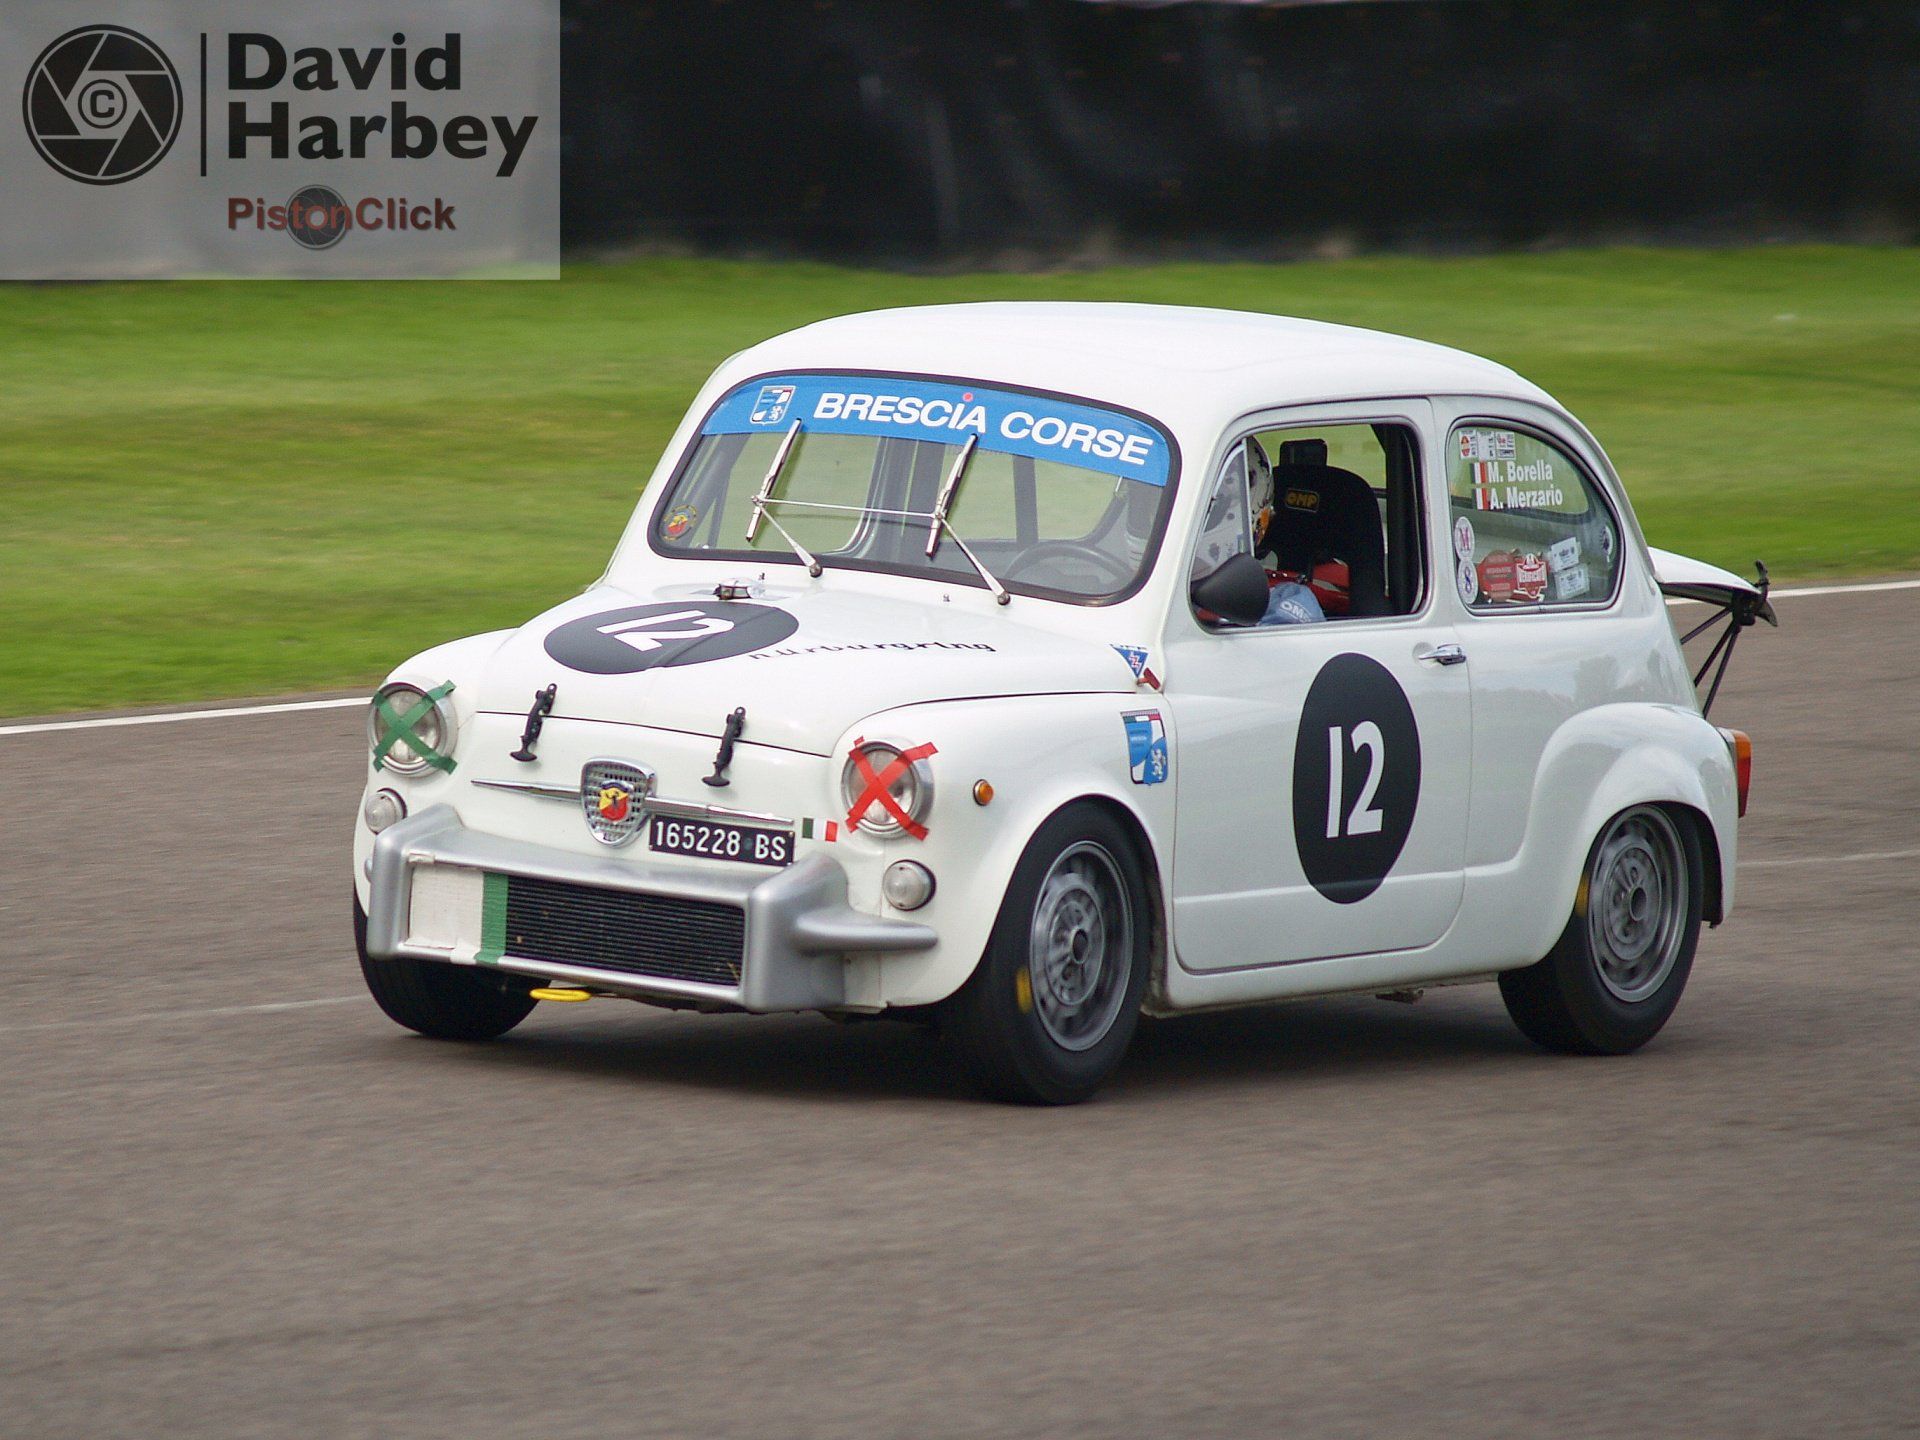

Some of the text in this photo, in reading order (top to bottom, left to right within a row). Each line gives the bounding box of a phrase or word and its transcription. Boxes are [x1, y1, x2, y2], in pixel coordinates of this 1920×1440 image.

[814, 392, 1153, 466] BRESCIA CORSE
[1488, 459, 1553, 483] M. Borella
[1286, 493, 1318, 508] OMP
[1490, 484, 1563, 510] A. Merzario
[596, 610, 735, 651] 12
[1326, 720, 1386, 839] 12
[655, 820, 787, 861] 165228 BS
